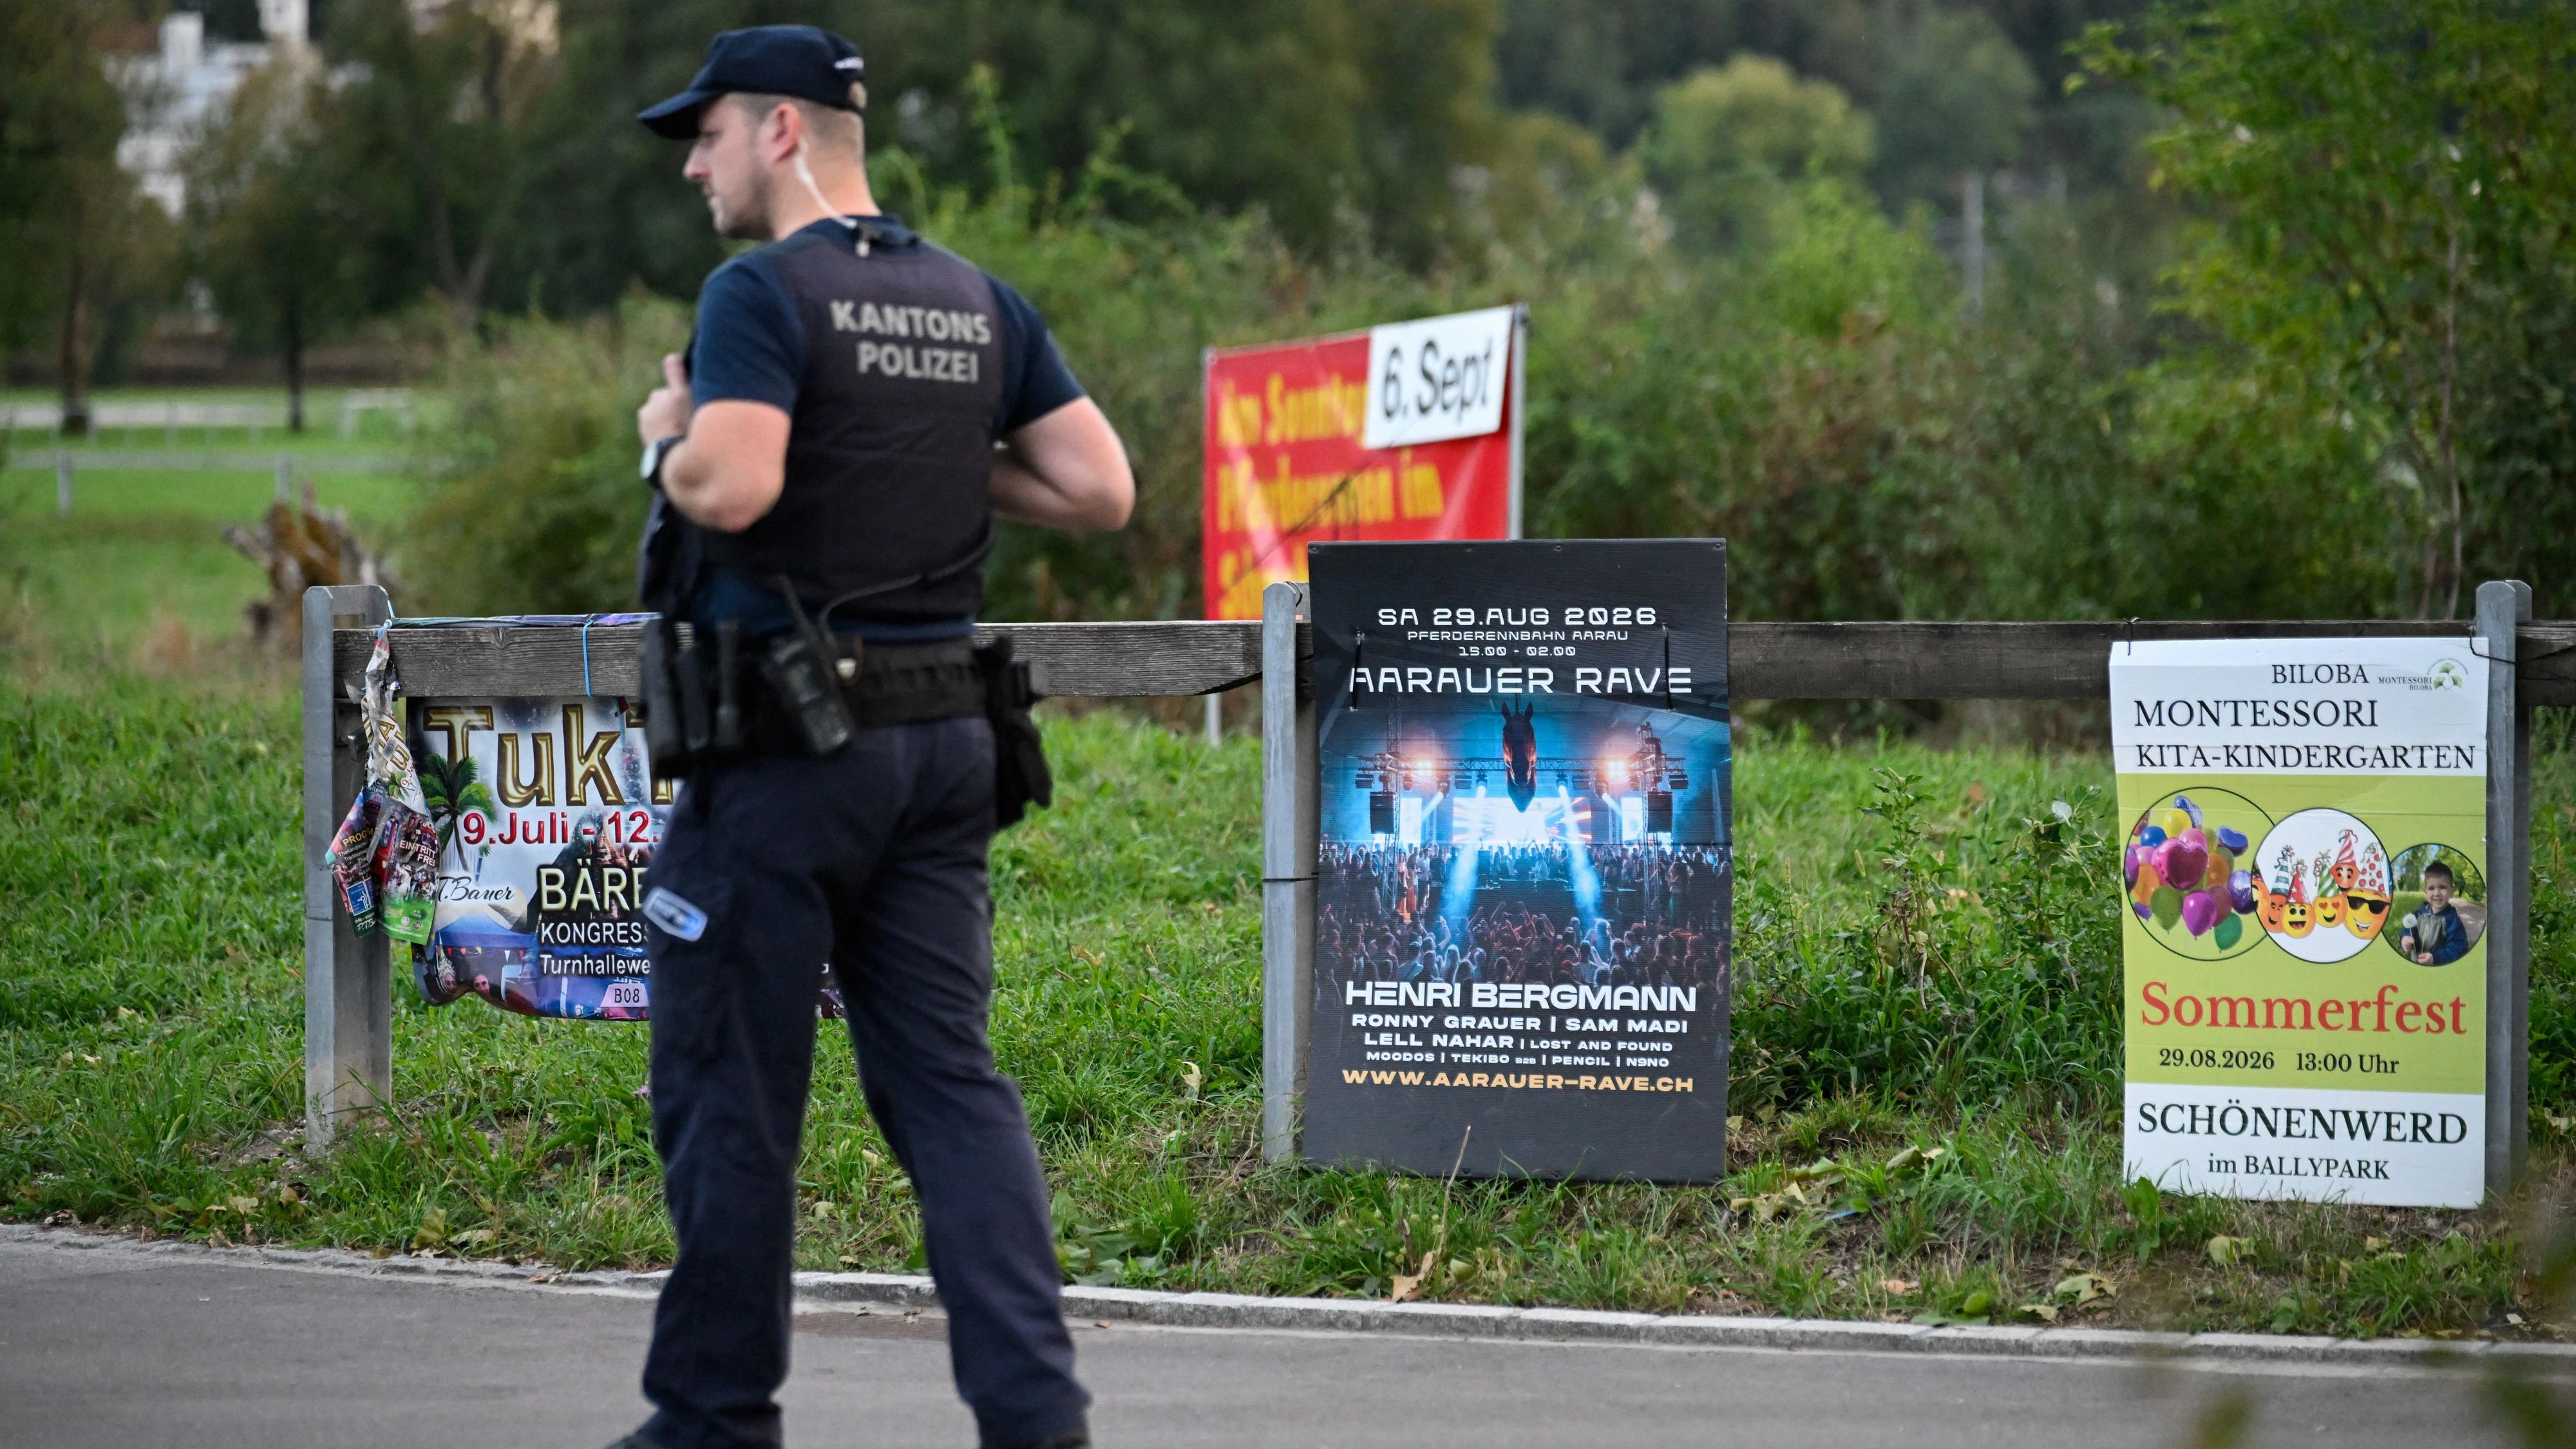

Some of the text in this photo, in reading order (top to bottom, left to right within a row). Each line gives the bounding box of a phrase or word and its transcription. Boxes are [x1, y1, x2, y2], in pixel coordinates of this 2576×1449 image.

[829, 299, 992, 345] KANTONS
[857, 340, 980, 383] POLIZEI
[1378, 607, 1656, 625] SA 29.AUG 2026
[1408, 630, 1628, 641] PFERDERENNBAHN AARAU
[1459, 646, 1506, 656] 15.00
[1526, 646, 1576, 656] 02.00
[1349, 667, 1692, 694] AARAUER RAVE
[2271, 664, 2369, 684] BILOBA
[2378, 676, 2432, 685] MONTESSORI
[2134, 699, 2378, 727] MONTESSORI
[2136, 744, 2474, 768] KITA-KINDERGARTEN
[464, 811, 569, 844] 9.Juli
[399, 839, 436, 859] EINTRITT
[417, 853, 436, 867] FREI
[614, 988, 639, 1003] B08
[1345, 980, 1696, 1012] HENRI BERGMANN
[2142, 981, 2467, 1034] Sommerfest
[1352, 1014, 1434, 1028] RONNY
[1444, 1016, 1541, 1030] GRAUER
[1566, 1018, 1618, 1032] SAM
[1627, 1019, 1688, 1034] MADI
[1364, 1032, 1423, 1046] LELL
[1432, 1034, 1514, 1048] NAHAR
[1530, 1039, 1571, 1050] LOST
[1577, 1041, 1611, 1050] AND
[1617, 1041, 1673, 1052] FOUND
[1367, 1051, 1435, 1062] MOODOS
[1451, 1054, 1510, 1064] TEKIBO
[1551, 1056, 1611, 1066] PENCIL
[1626, 1057, 1669, 1067] N9NO
[2159, 1048, 2400, 1074] 29.08.2026 13:00 Uhr
[1342, 1070, 1693, 1092] WWW.AARAUER-RAVE.CH
[2138, 1099, 2467, 1144] SCHÖNENWERD
[2208, 1153, 2390, 1180] im BALLYPARK
